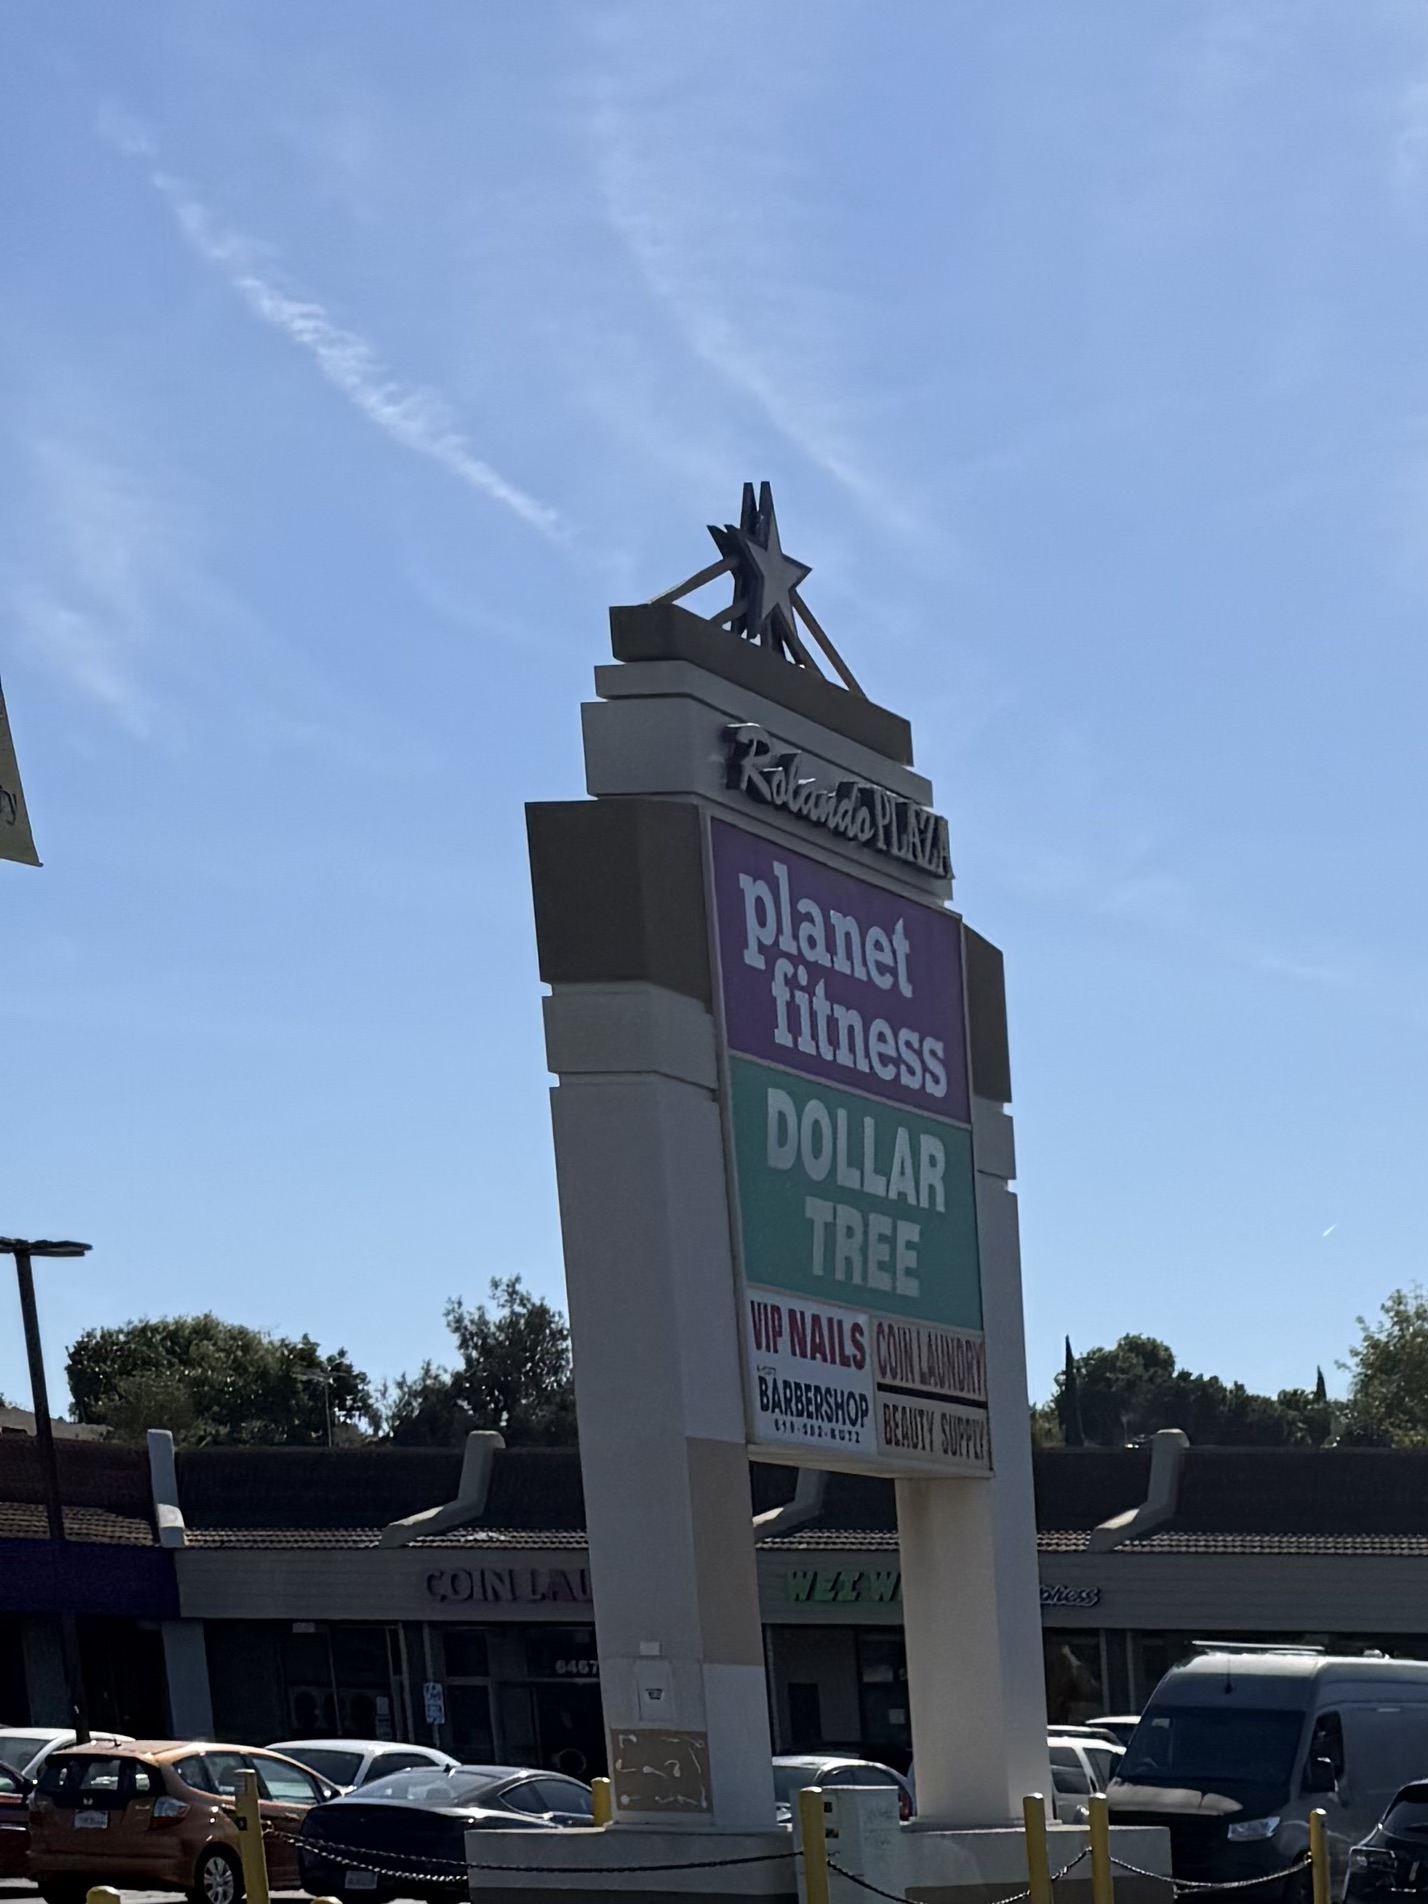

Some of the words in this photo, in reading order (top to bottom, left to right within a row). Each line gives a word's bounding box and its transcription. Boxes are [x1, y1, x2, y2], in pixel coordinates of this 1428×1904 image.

[874, 789, 950, 877] PLAZA
[739, 860, 913, 998] planet
[772, 957, 947, 1097] fitness
[767, 1088, 946, 1213] DOLLAR
[805, 1196, 921, 1297] TREE
[750, 1300, 783, 1354] VIP
[788, 1308, 866, 1371] NAILS
[876, 1321, 916, 1384] COIN
[916, 1327, 984, 1397] LAUNDRY
[758, 1375, 870, 1428] BARBERSHOP
[883, 1404, 935, 1453] BEAUTY
[941, 1412, 986, 1460] SUPPLY
[426, 1568, 516, 1602] COIN
